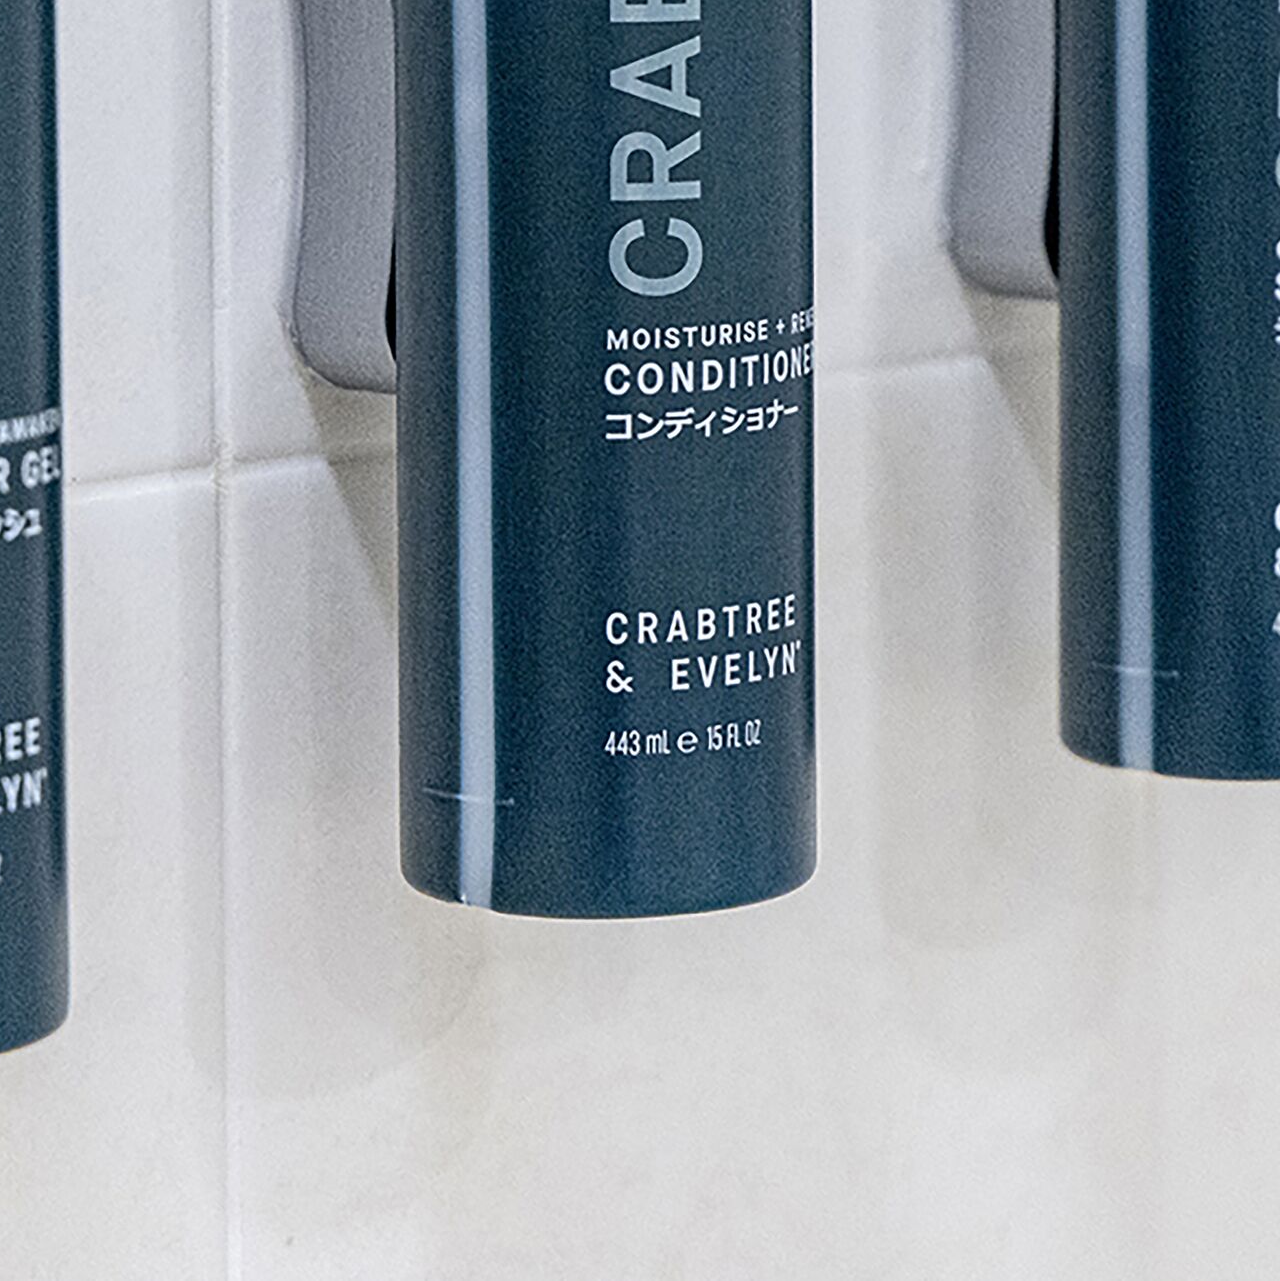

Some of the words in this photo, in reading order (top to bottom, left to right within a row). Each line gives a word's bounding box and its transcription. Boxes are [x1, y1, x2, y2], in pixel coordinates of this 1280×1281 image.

[606, 319, 769, 351] MOISTURISE
[605, 399, 799, 440] コンディショナー
[605, 594, 795, 645] CRABTREE
[606, 660, 634, 693] &
[604, 730, 641, 757] 443
[706, 723, 723, 751] 15
